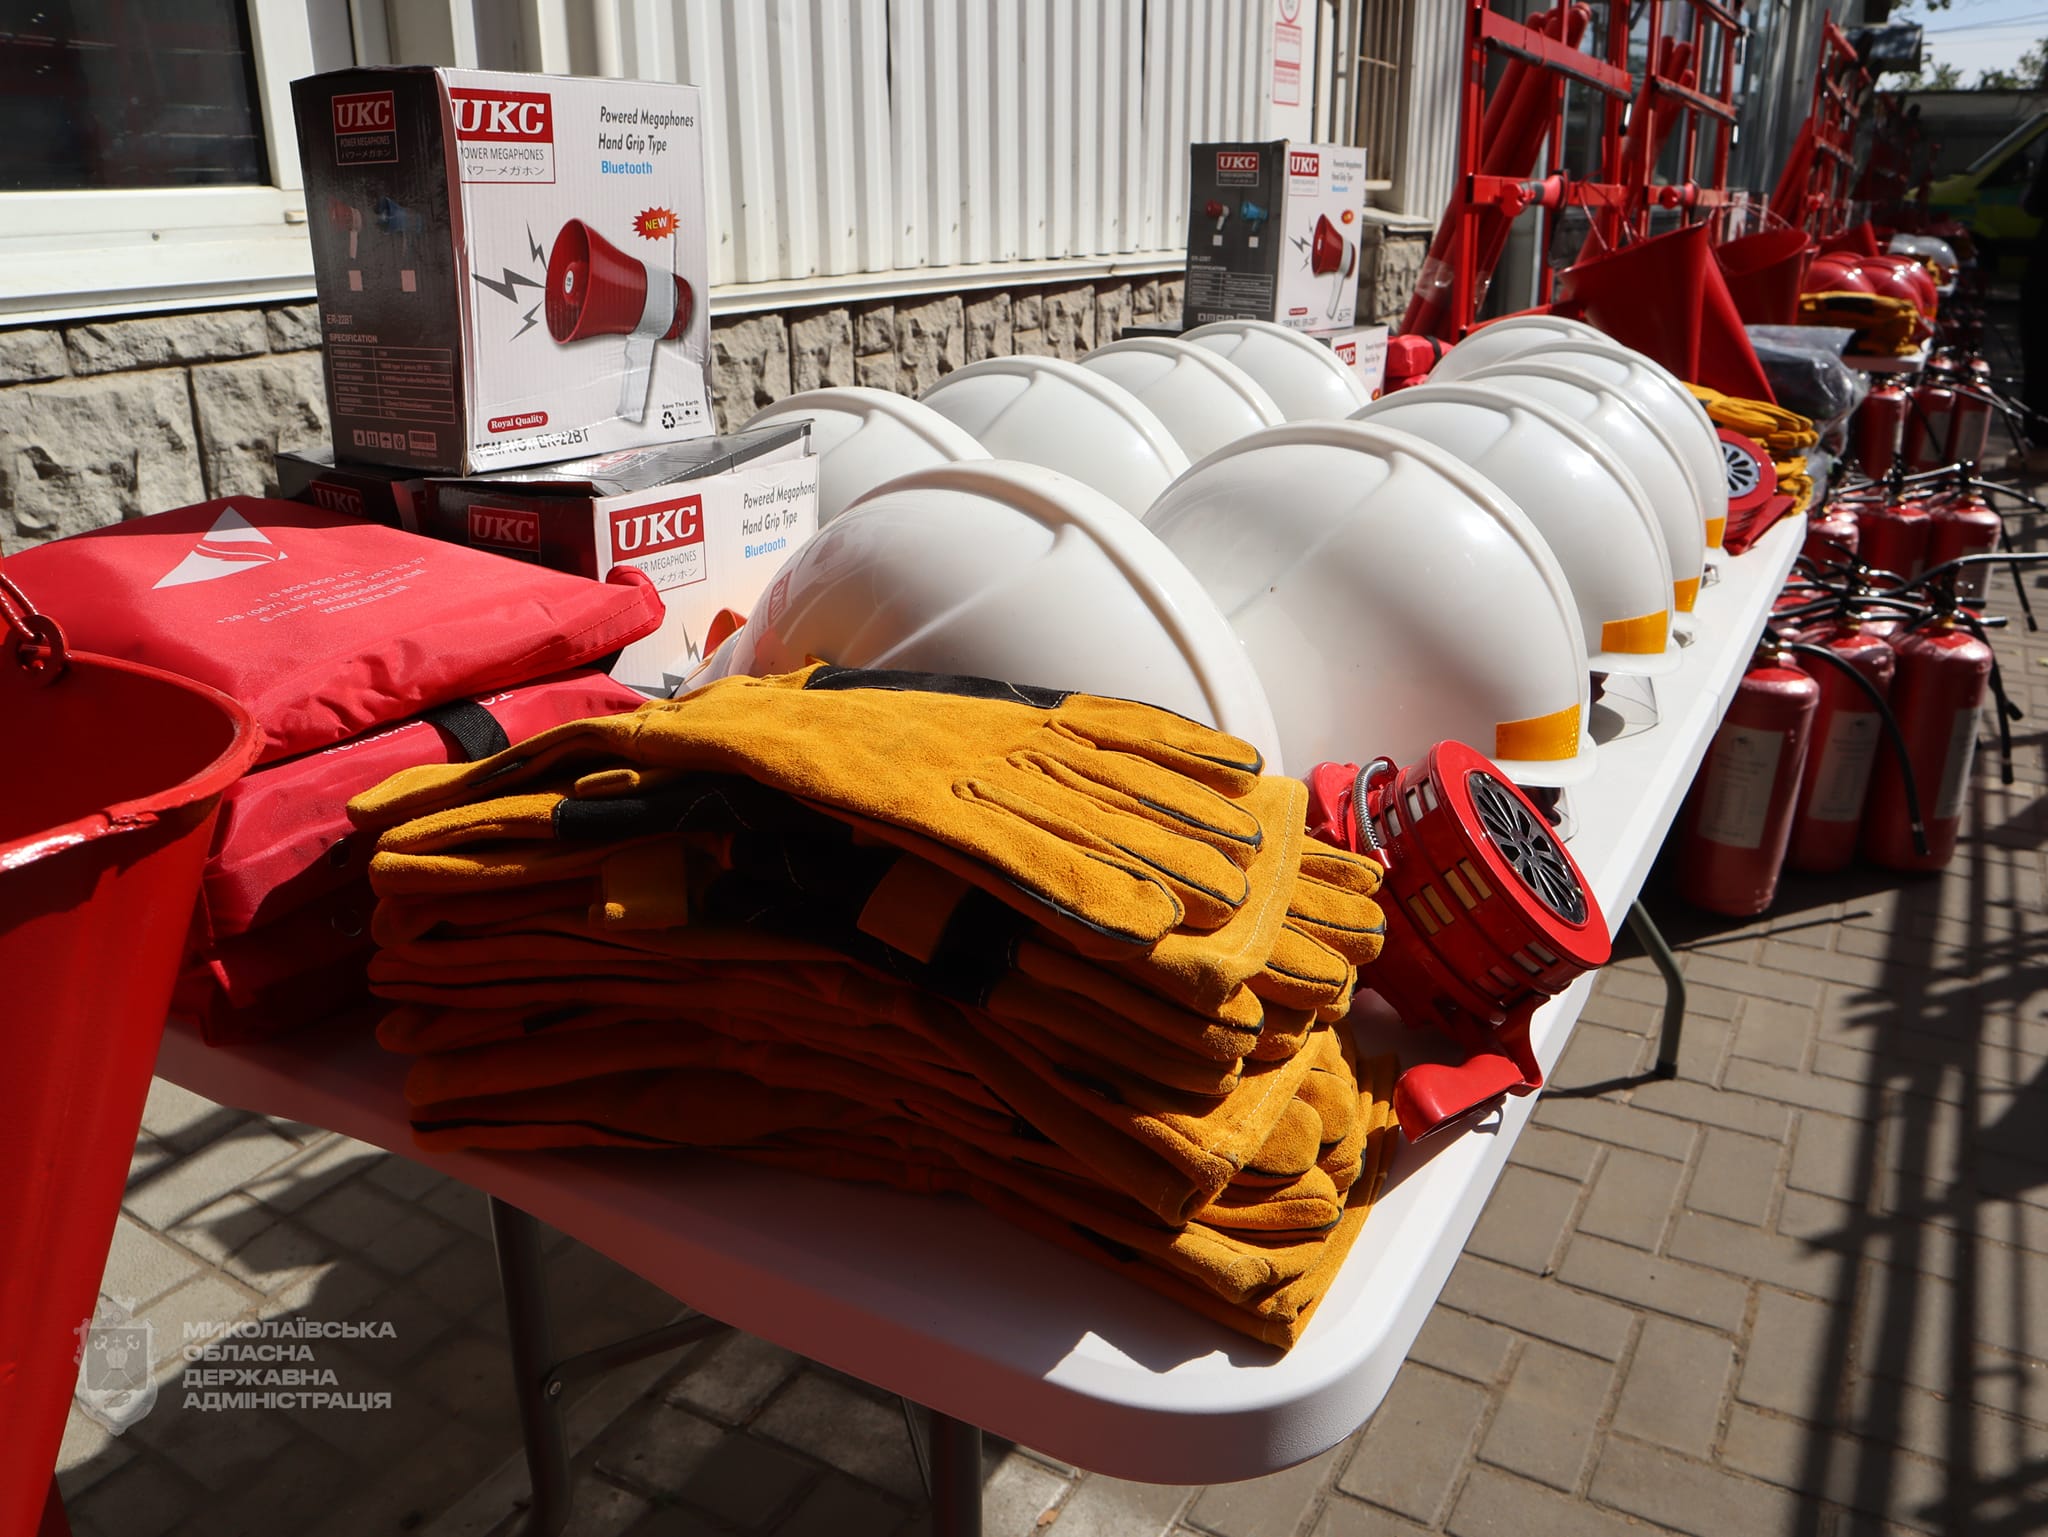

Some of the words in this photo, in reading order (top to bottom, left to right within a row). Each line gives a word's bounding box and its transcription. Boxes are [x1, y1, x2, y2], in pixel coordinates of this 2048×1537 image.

[336, 100, 390, 128] UKC
[452, 98, 545, 134] UKC
[600, 106, 639, 124] Powered
[640, 109, 694, 129] Megaphones
[490, 148, 544, 161] MEGAPHONES
[598, 132, 624, 150] Hand
[626, 134, 645, 154] Grip
[647, 135, 667, 155] Type
[601, 160, 653, 174] Bluetooth
[1220, 155, 1257, 169] UKC
[1291, 156, 1317, 173] UKC
[645, 216, 668, 231] NEW
[329, 333, 378, 344] SPECIFICATION
[491, 418, 514, 430] Royal
[515, 415, 543, 427] Quality
[315, 488, 362, 516] UKC
[743, 487, 775, 509] Powered
[776, 481, 816, 503] Megaphone
[472, 514, 535, 544] UKC
[615, 505, 697, 551] UKC
[742, 515, 763, 536] Hand
[764, 513, 780, 532] Grip
[782, 509, 798, 529] Type
[744, 537, 786, 558] Bluetooth
[650, 550, 697, 572] MEGAPHONES
